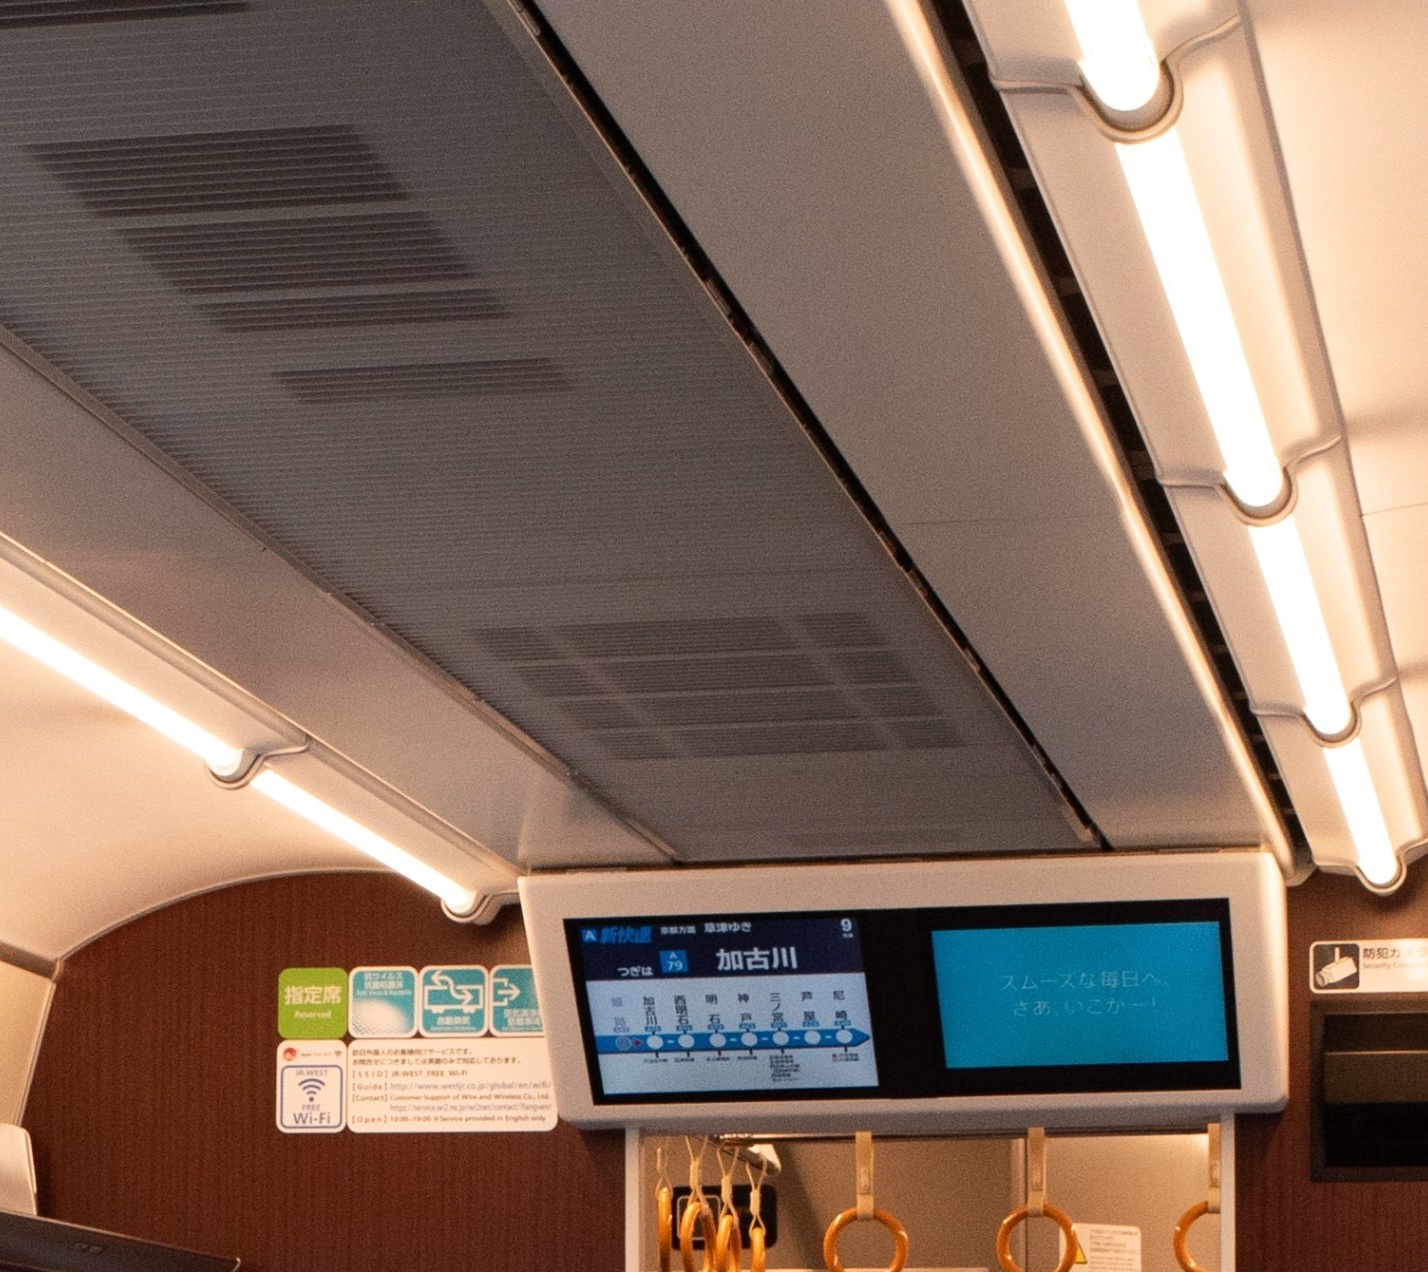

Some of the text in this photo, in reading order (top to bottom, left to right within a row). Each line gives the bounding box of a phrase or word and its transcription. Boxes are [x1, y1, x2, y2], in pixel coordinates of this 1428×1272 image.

[600, 925, 652, 944] 新快速
[840, 918, 852, 932] 9
[617, 965, 654, 977] つぎは
[715, 946, 798, 971] 加古川
[668, 961, 683, 971] 79
[284, 985, 342, 1005] 指定席
[294, 1010, 332, 1019] Reserved
[643, 996, 658, 1026] 加古川
[674, 995, 690, 1025] 西明石
[706, 994, 721, 1024] 明石
[293, 1111, 331, 1125] Wi-Fi
